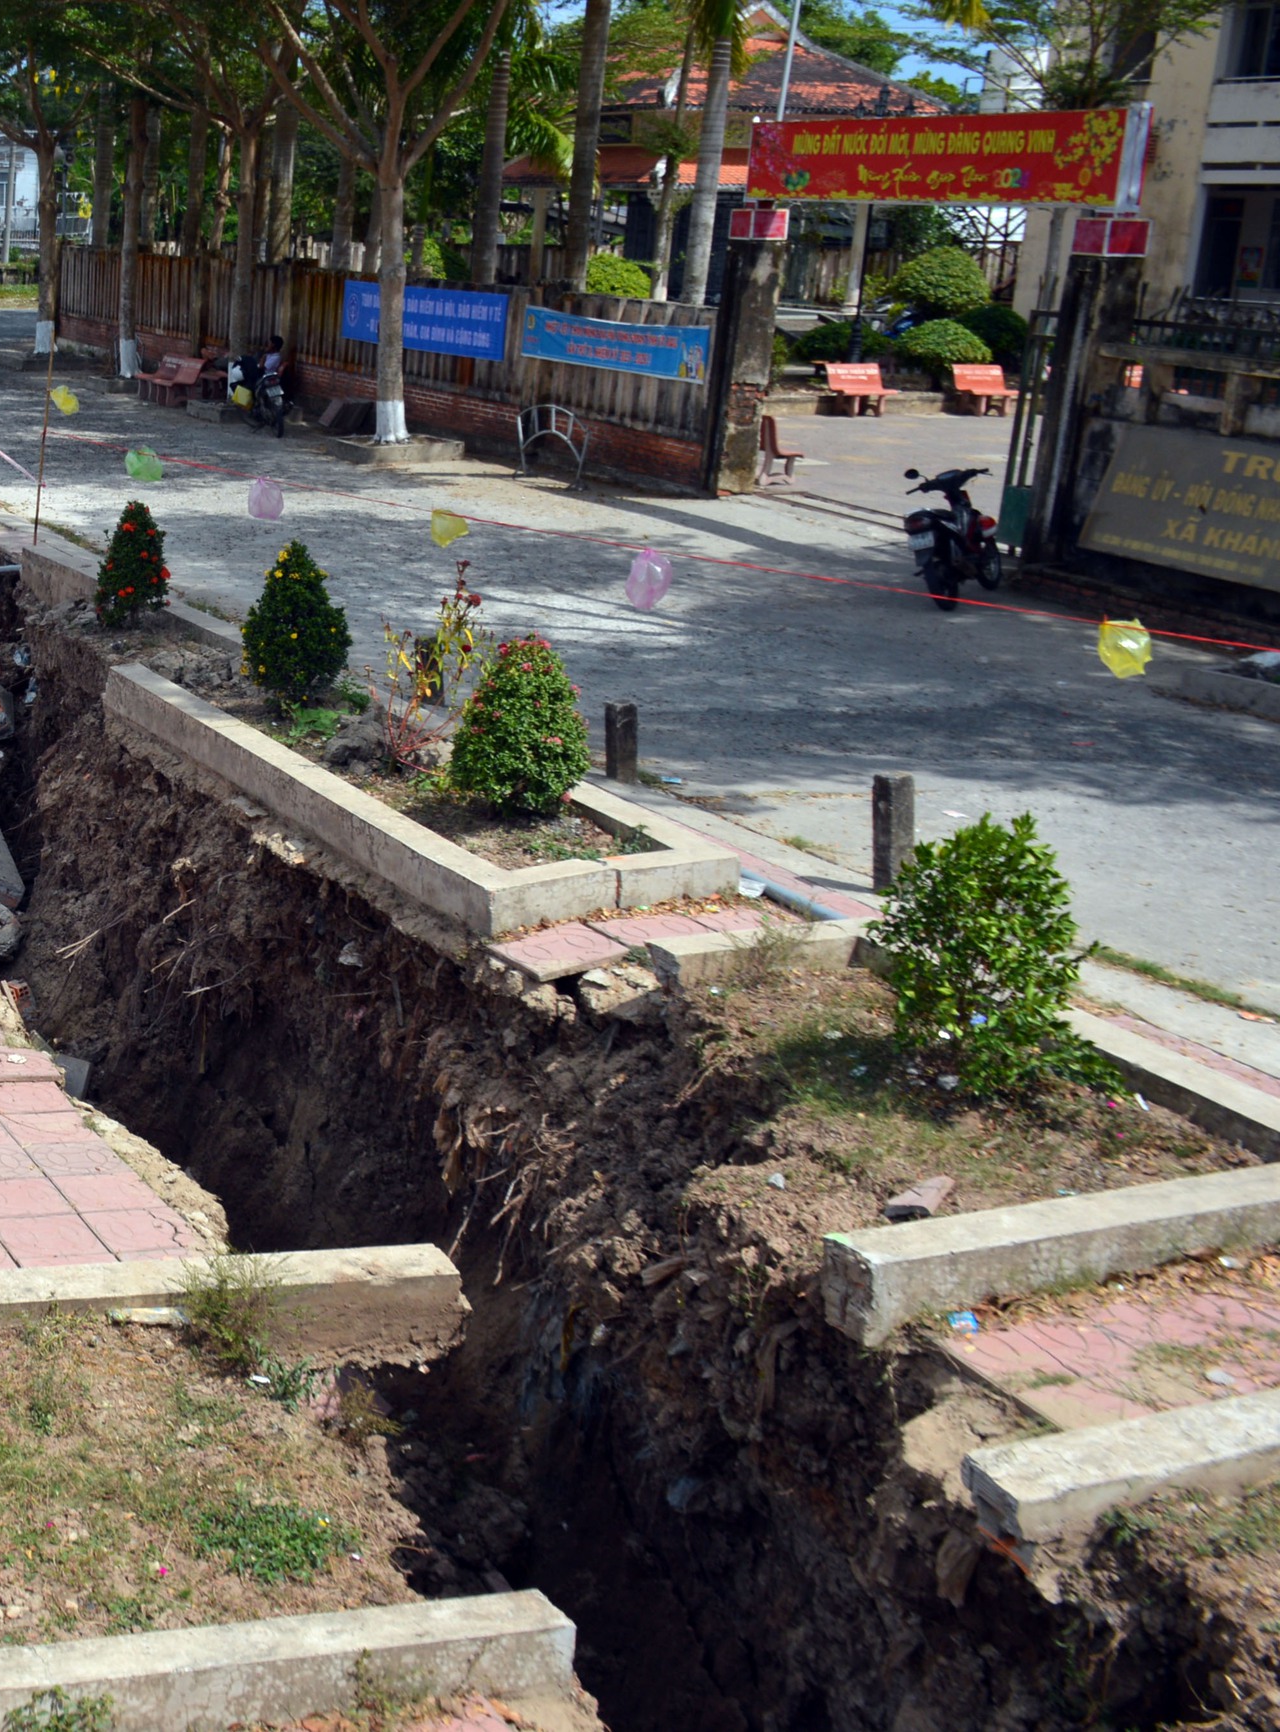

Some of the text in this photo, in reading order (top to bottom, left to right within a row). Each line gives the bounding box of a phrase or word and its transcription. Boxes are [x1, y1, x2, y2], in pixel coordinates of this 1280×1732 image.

[792, 129, 821, 154] MỪNG
[822, 125, 842, 154] ĐẤT
[842, 127, 869, 154] NƯỚC
[912, 127, 946, 154] MỪNG
[947, 123, 981, 154] ĐẢNG
[982, 130, 1025, 156] QUANG
[1026, 129, 1056, 153] VINH
[1161, 516, 1203, 544] XÃ
